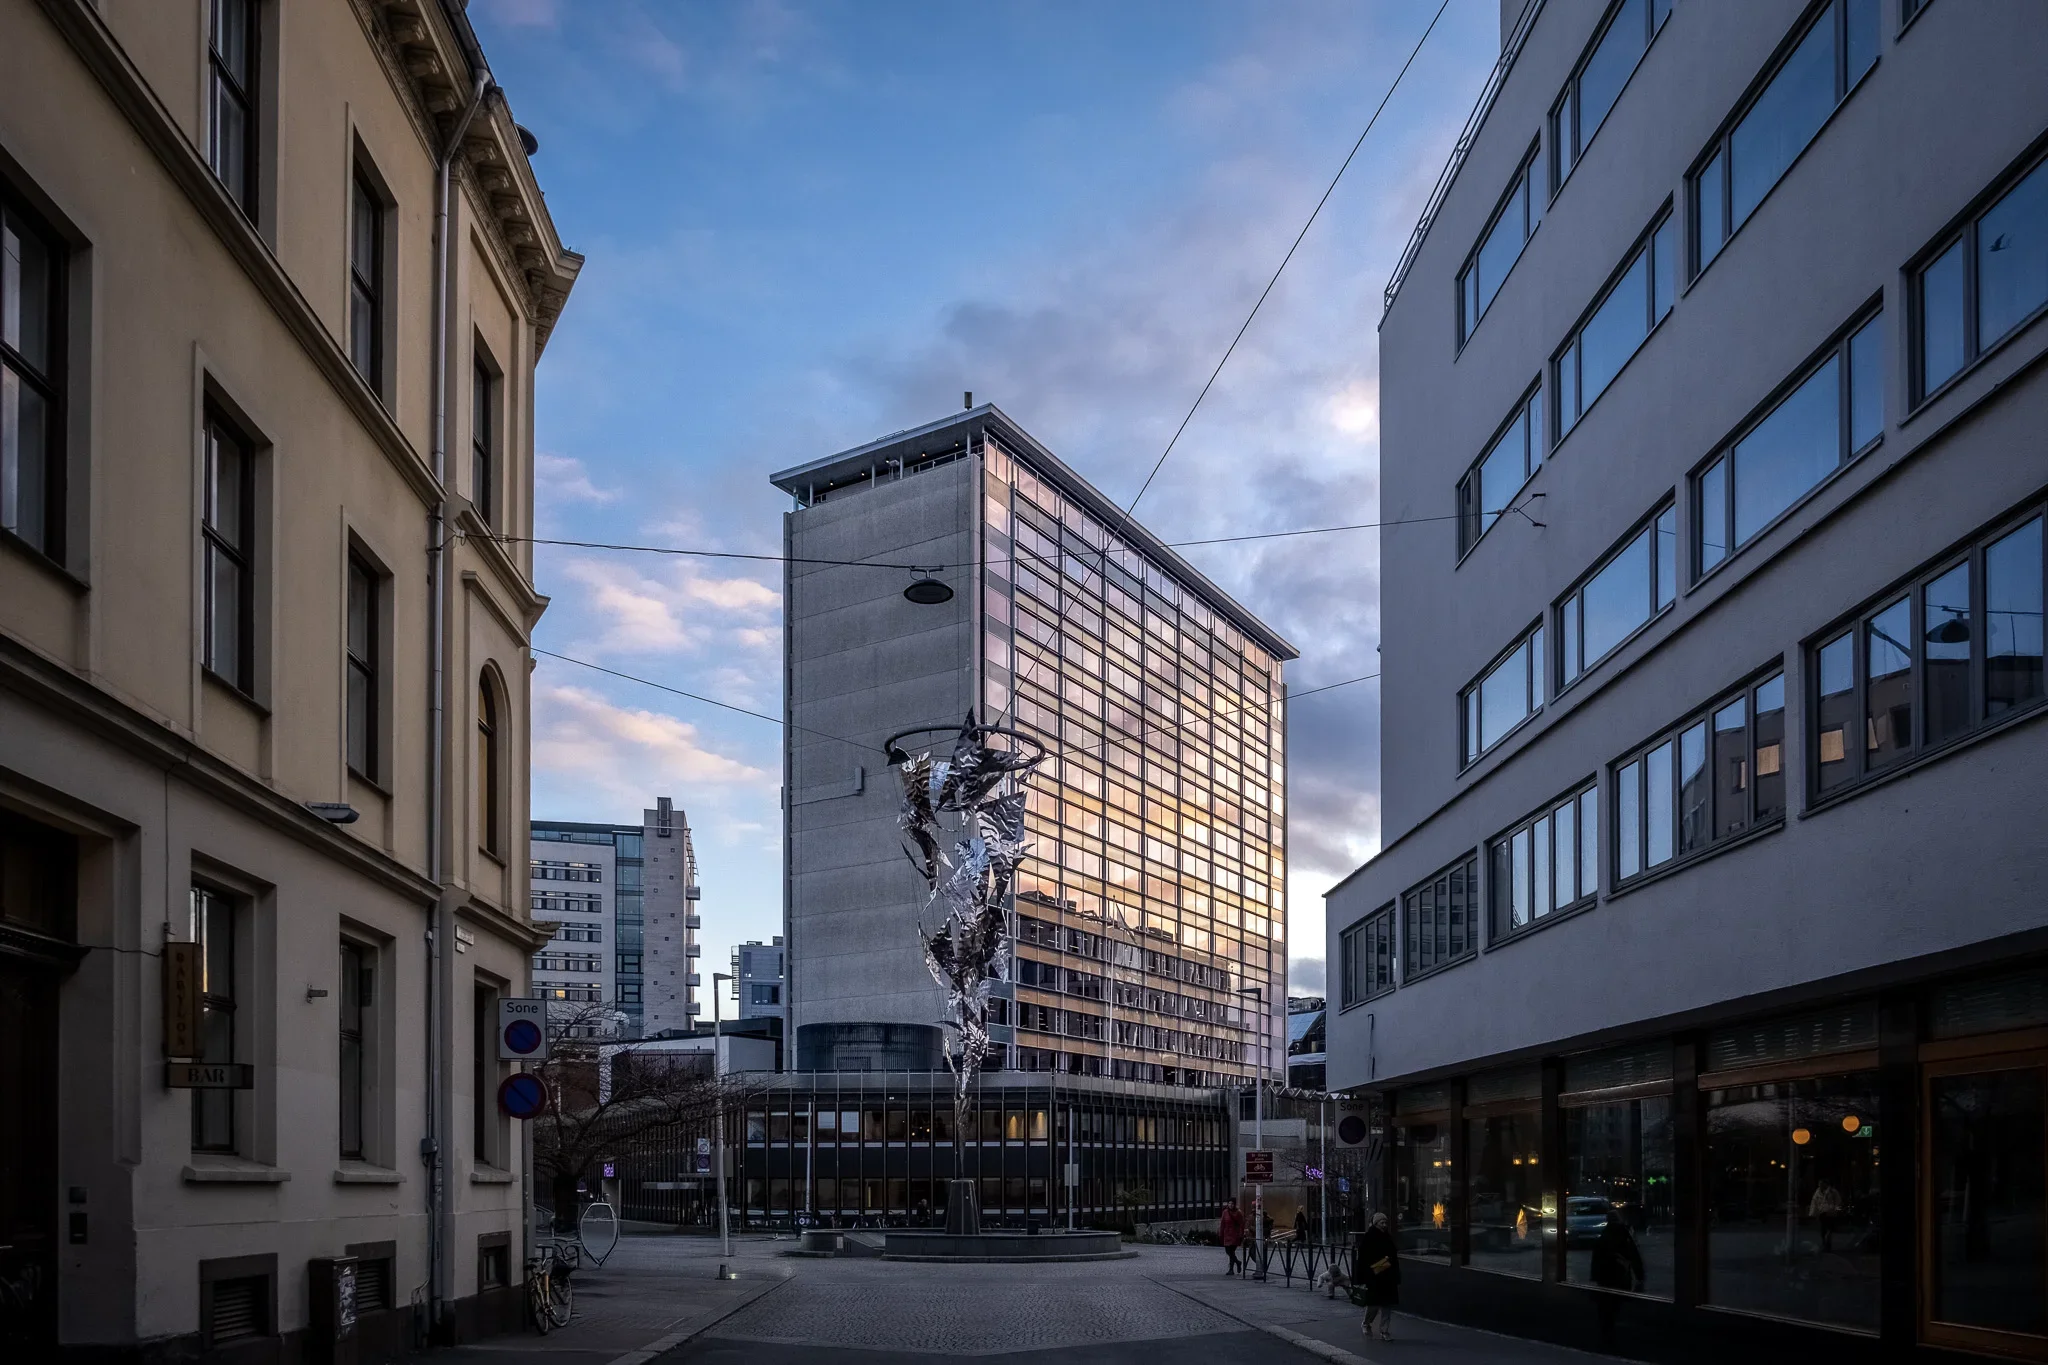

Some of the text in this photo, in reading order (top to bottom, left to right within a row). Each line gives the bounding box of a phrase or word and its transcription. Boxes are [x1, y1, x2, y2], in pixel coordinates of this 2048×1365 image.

[506, 1002, 539, 1014] Sone
[188, 1068, 224, 1083] BAR
[1340, 1102, 1365, 1112] Sone
